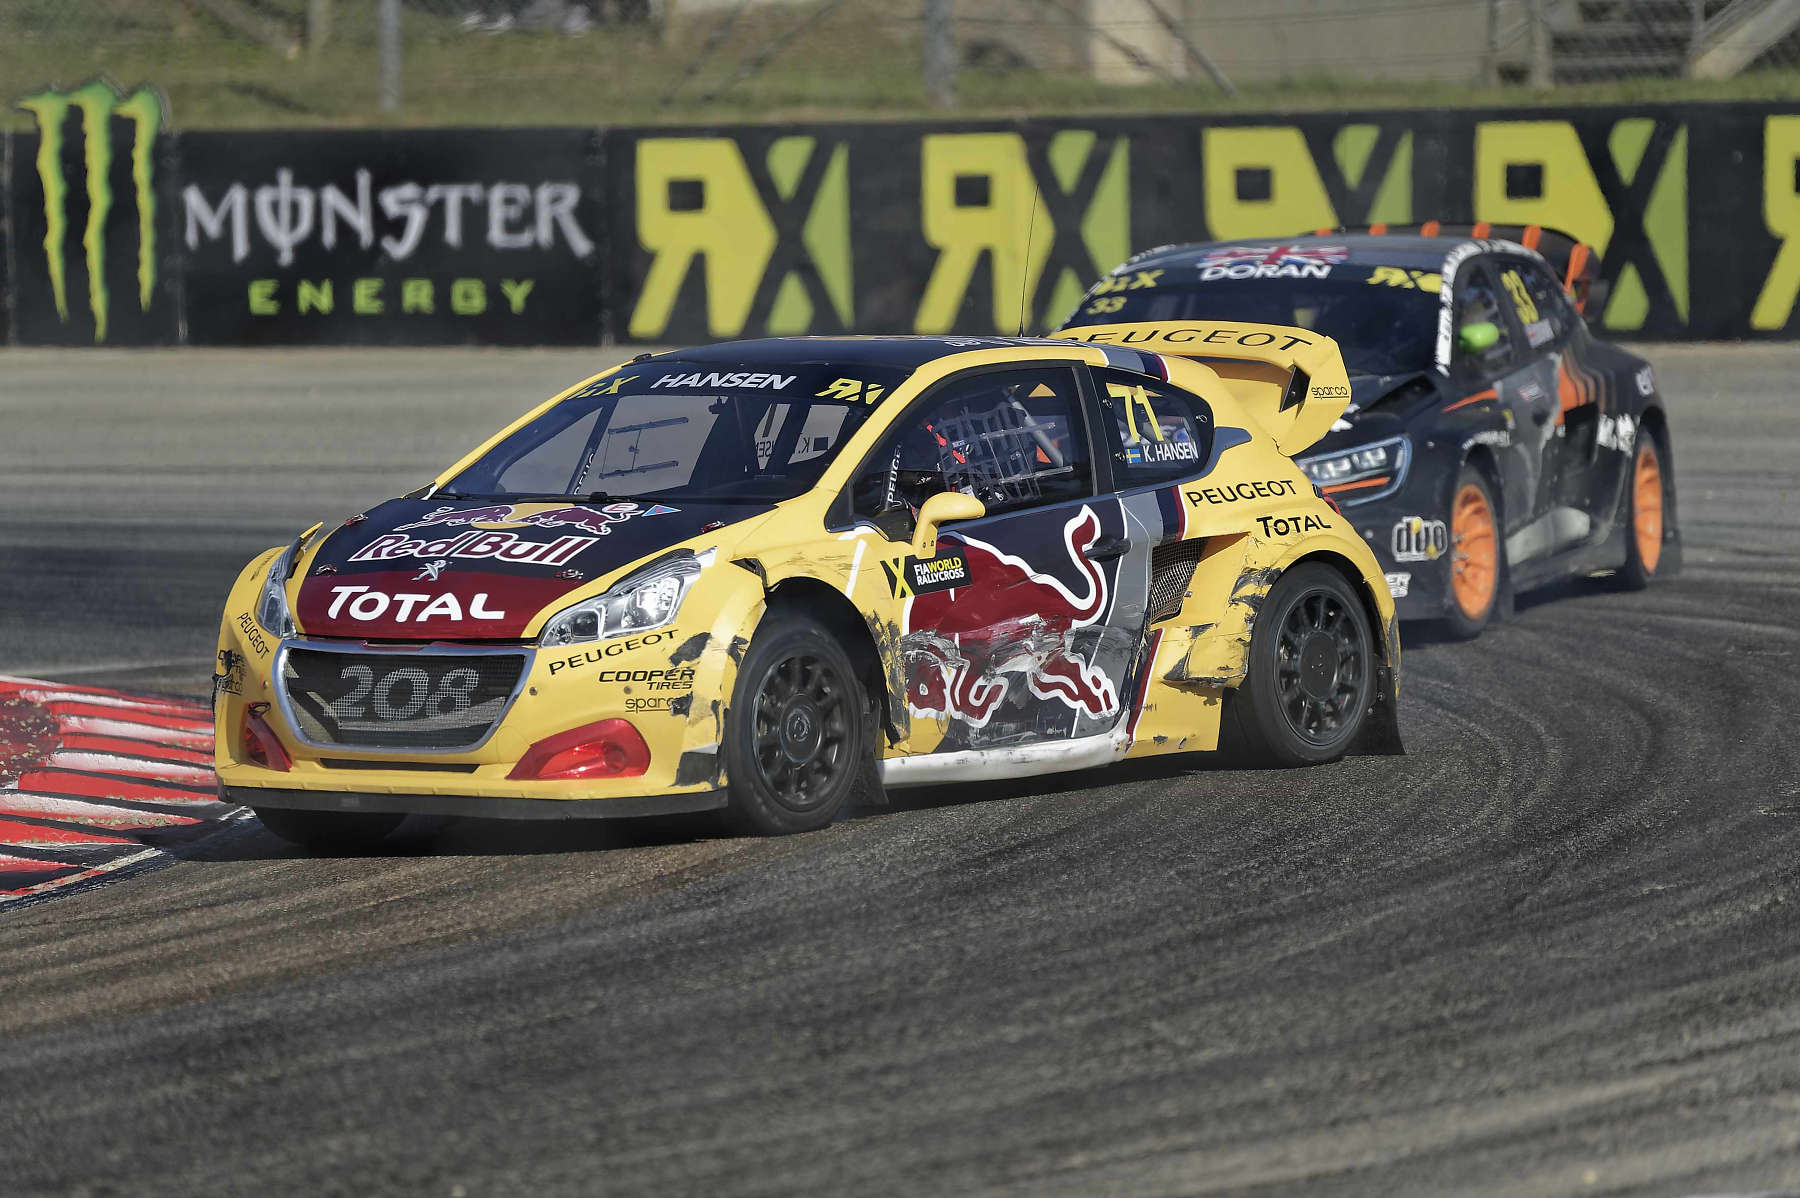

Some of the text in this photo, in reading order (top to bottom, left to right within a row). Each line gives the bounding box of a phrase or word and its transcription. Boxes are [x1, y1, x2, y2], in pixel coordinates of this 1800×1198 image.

[182, 167, 594, 267] MONSTER
[628, 136, 854, 338] RX
[1201, 264, 1333, 281] DORAN
[248, 278, 534, 315] ENERGY
[1087, 296, 1128, 315] 33
[1060, 328, 1313, 352] EUGEOT
[650, 372, 797, 390] HANSEN
[1311, 386, 1350, 400] sparco
[1105, 384, 1165, 443] 71
[1142, 441, 1199, 463] K. HANSEN
[1185, 480, 1297, 507] PEUGEOT
[1256, 514, 1332, 539] TOTAL
[916, 567, 965, 586] RALLYCROSS
[327, 585, 506, 623] TOTAL
[236, 611, 271, 660] PEUGEOT
[548, 629, 680, 676] PEUGEOT
[599, 668, 696, 683] COOPER
[646, 680, 694, 691] TIRES
[325, 663, 480, 721] 208
